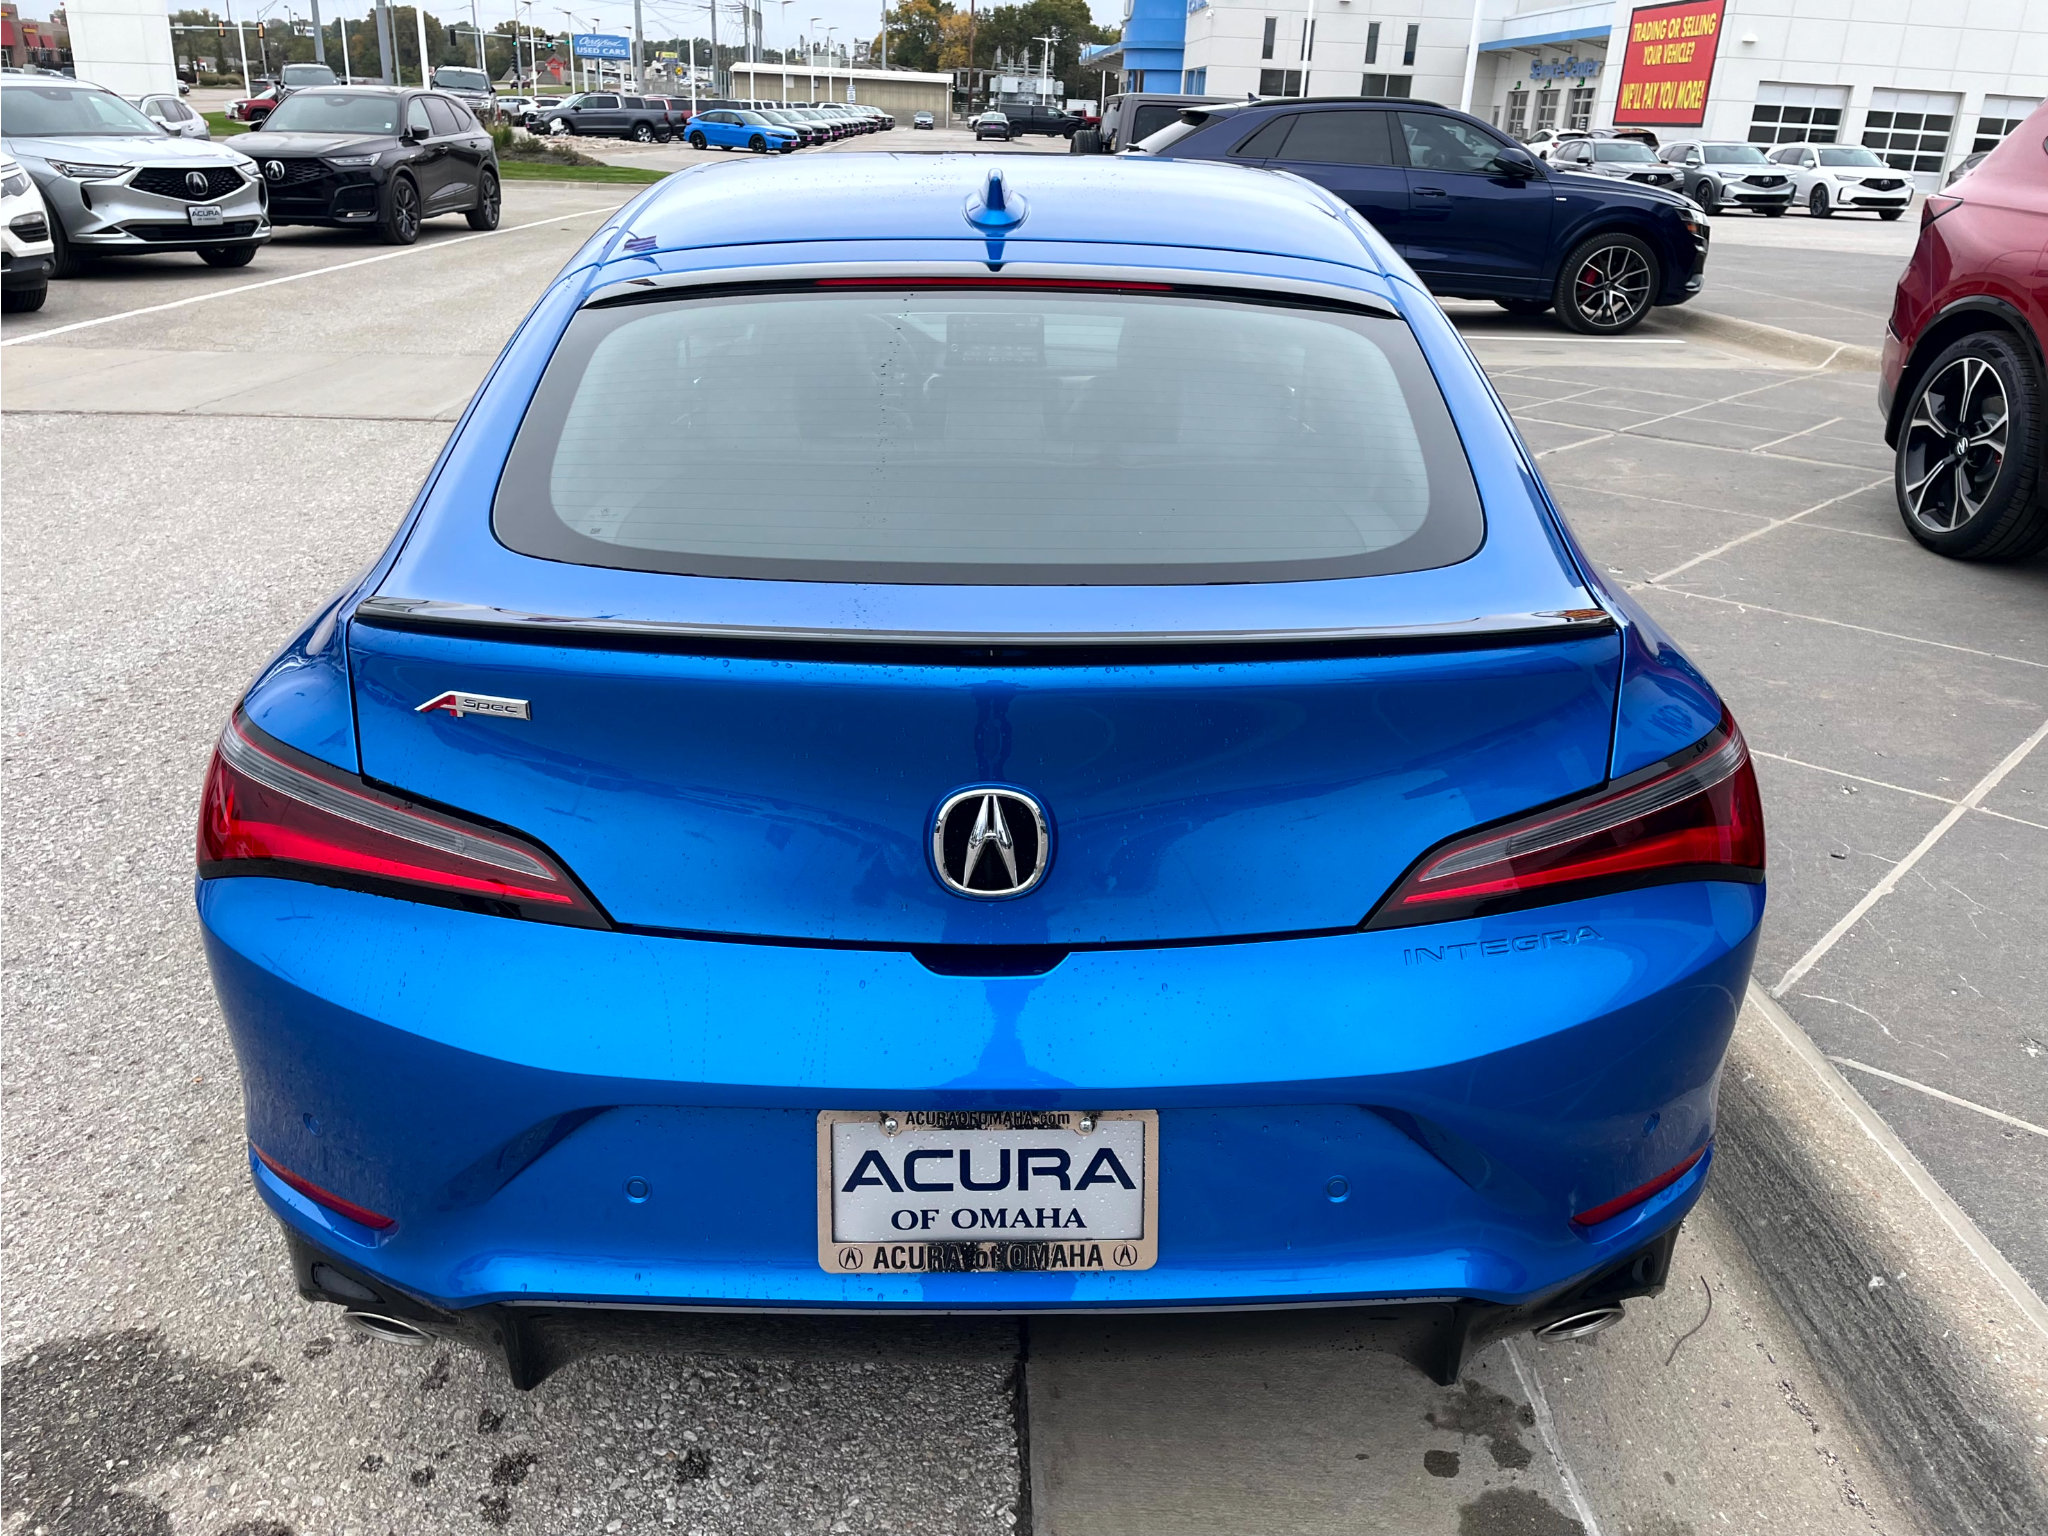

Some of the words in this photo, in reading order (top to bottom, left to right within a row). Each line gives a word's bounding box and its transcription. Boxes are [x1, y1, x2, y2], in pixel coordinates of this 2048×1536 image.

[1633, 19, 1667, 42] TRADING
[1667, 18, 1682, 39] OR
[1681, 13, 1717, 38] SELLING
[576, 46, 600, 54] USED
[602, 47, 626, 56] CARS
[579, 36, 623, 47] Certified
[1643, 44, 1662, 65] YOUR
[1663, 41, 1695, 64] VEHICLE?
[1529, 59, 1565, 79] Service
[1564, 56, 1602, 78] Center
[1620, 83, 1642, 110] WE'LL
[1641, 82, 1659, 109] PAY
[1658, 81, 1677, 110] YOU
[1675, 80, 1705, 110] MORE!
[1403, 925, 1604, 966] INTEGRA
[905, 1111, 1071, 1126] ACURAOFOMAHA.com
[841, 1147, 1137, 1193] ACURA
[891, 1209, 940, 1231] OF
[951, 1207, 1087, 1230] OMAHA
[873, 1245, 964, 1270] ACURA
[975, 1245, 999, 1269] of
[1008, 1243, 1104, 1269] OMAHA
